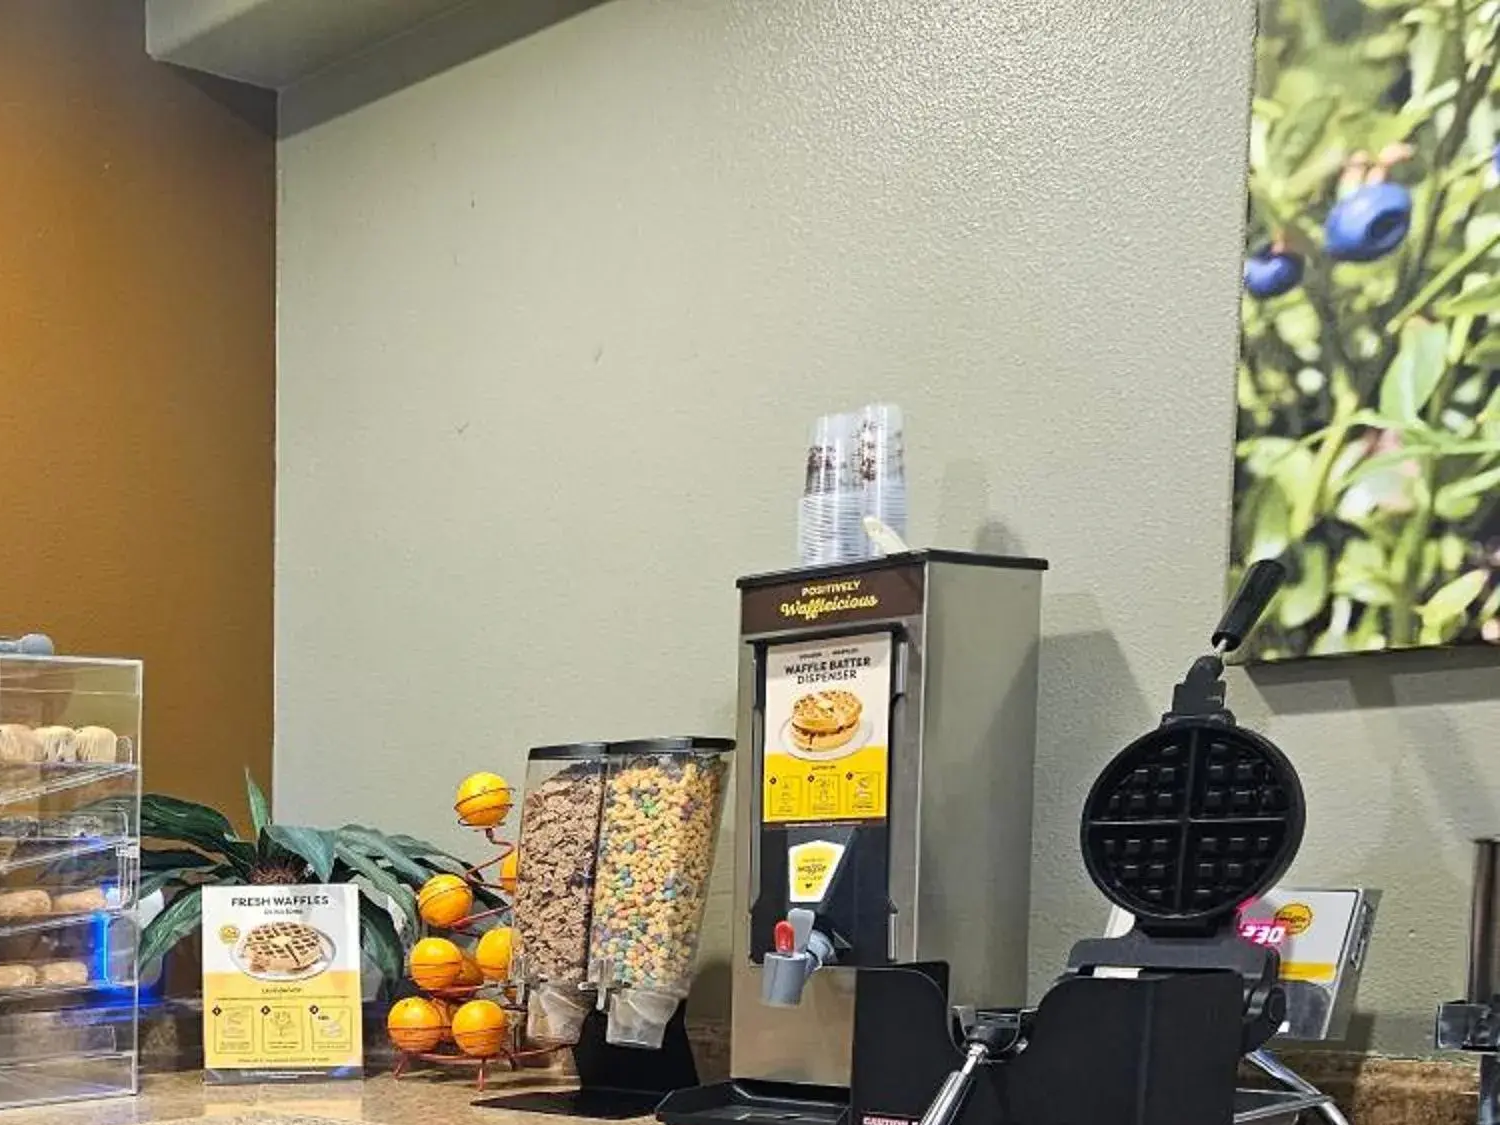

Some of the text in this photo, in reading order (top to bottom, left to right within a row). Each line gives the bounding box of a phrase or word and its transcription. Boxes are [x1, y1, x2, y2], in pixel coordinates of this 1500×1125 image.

[801, 579, 862, 597] POSITIVELY
[784, 656, 871, 675] WAFFLE BATTER
[797, 669, 857, 684] DISPENSER
[231, 895, 329, 907] FRESH WAFFLES
